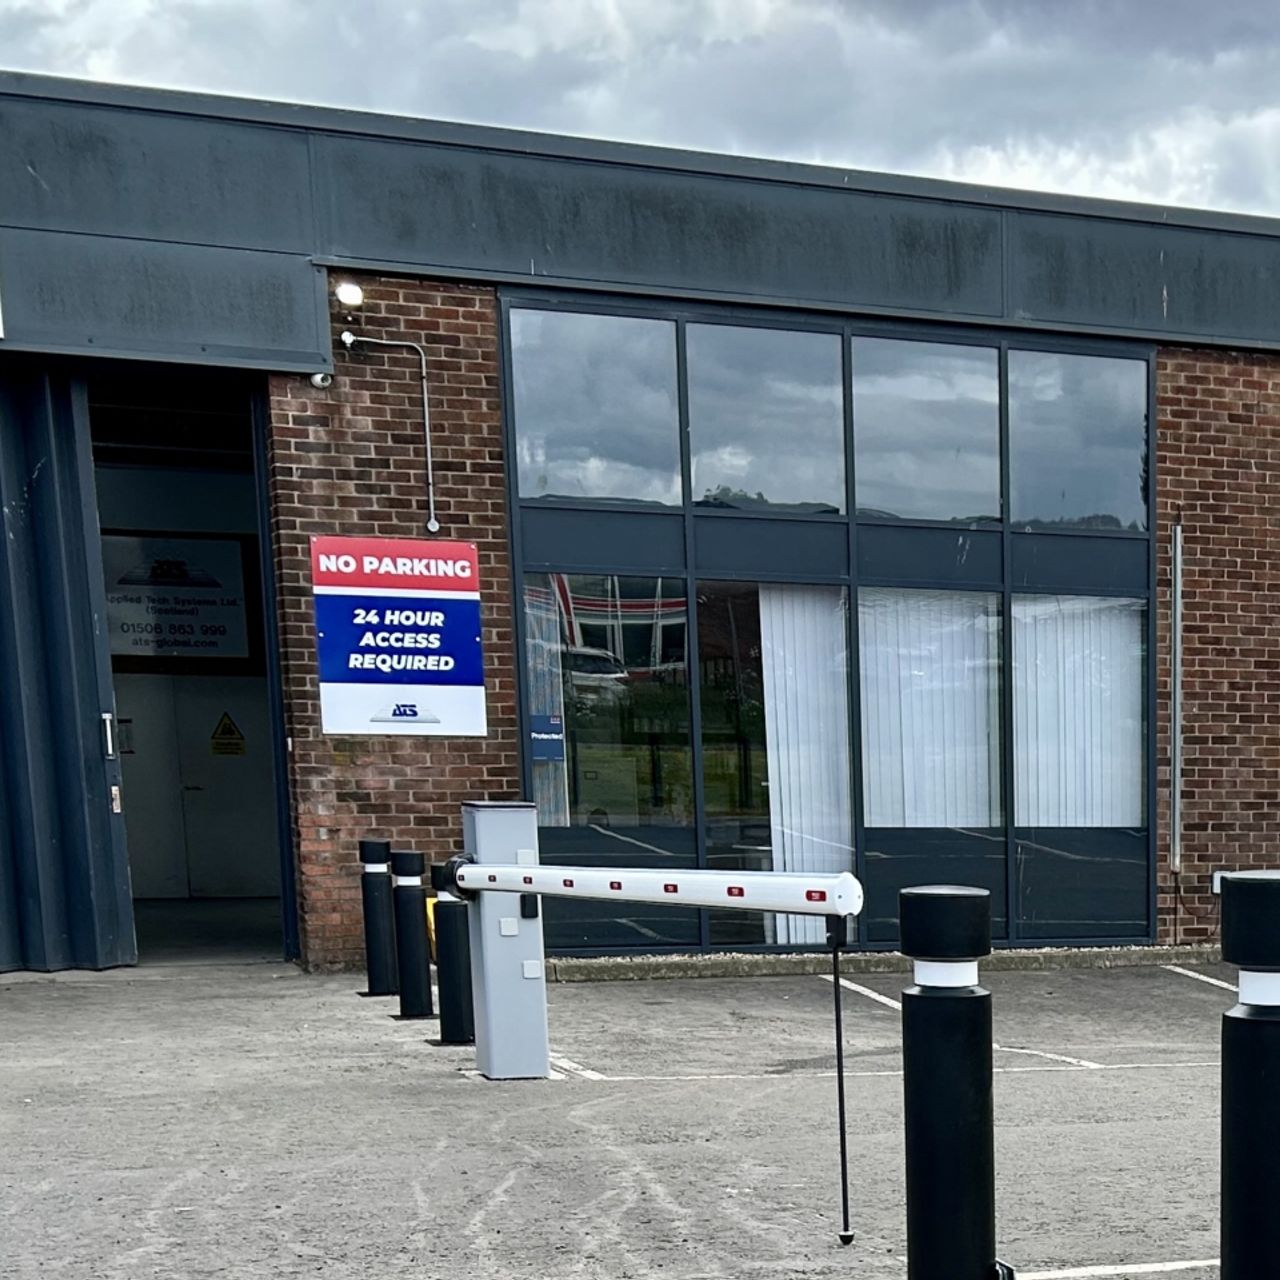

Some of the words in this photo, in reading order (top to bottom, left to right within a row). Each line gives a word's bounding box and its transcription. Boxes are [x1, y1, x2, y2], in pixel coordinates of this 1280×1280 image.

[318, 554, 357, 573] NO
[363, 555, 472, 578] PARKING
[145, 595, 169, 605] Tech
[173, 596, 217, 607] Systems
[145, 605, 199, 617] (Scotland)
[353, 608, 380, 624] 24
[384, 610, 445, 627] HOUR
[131, 637, 219, 649] ats-global.com
[358, 631, 441, 649] ACCESS
[348, 653, 455, 673] REQUIRED
[391, 704, 418, 718] ATS
